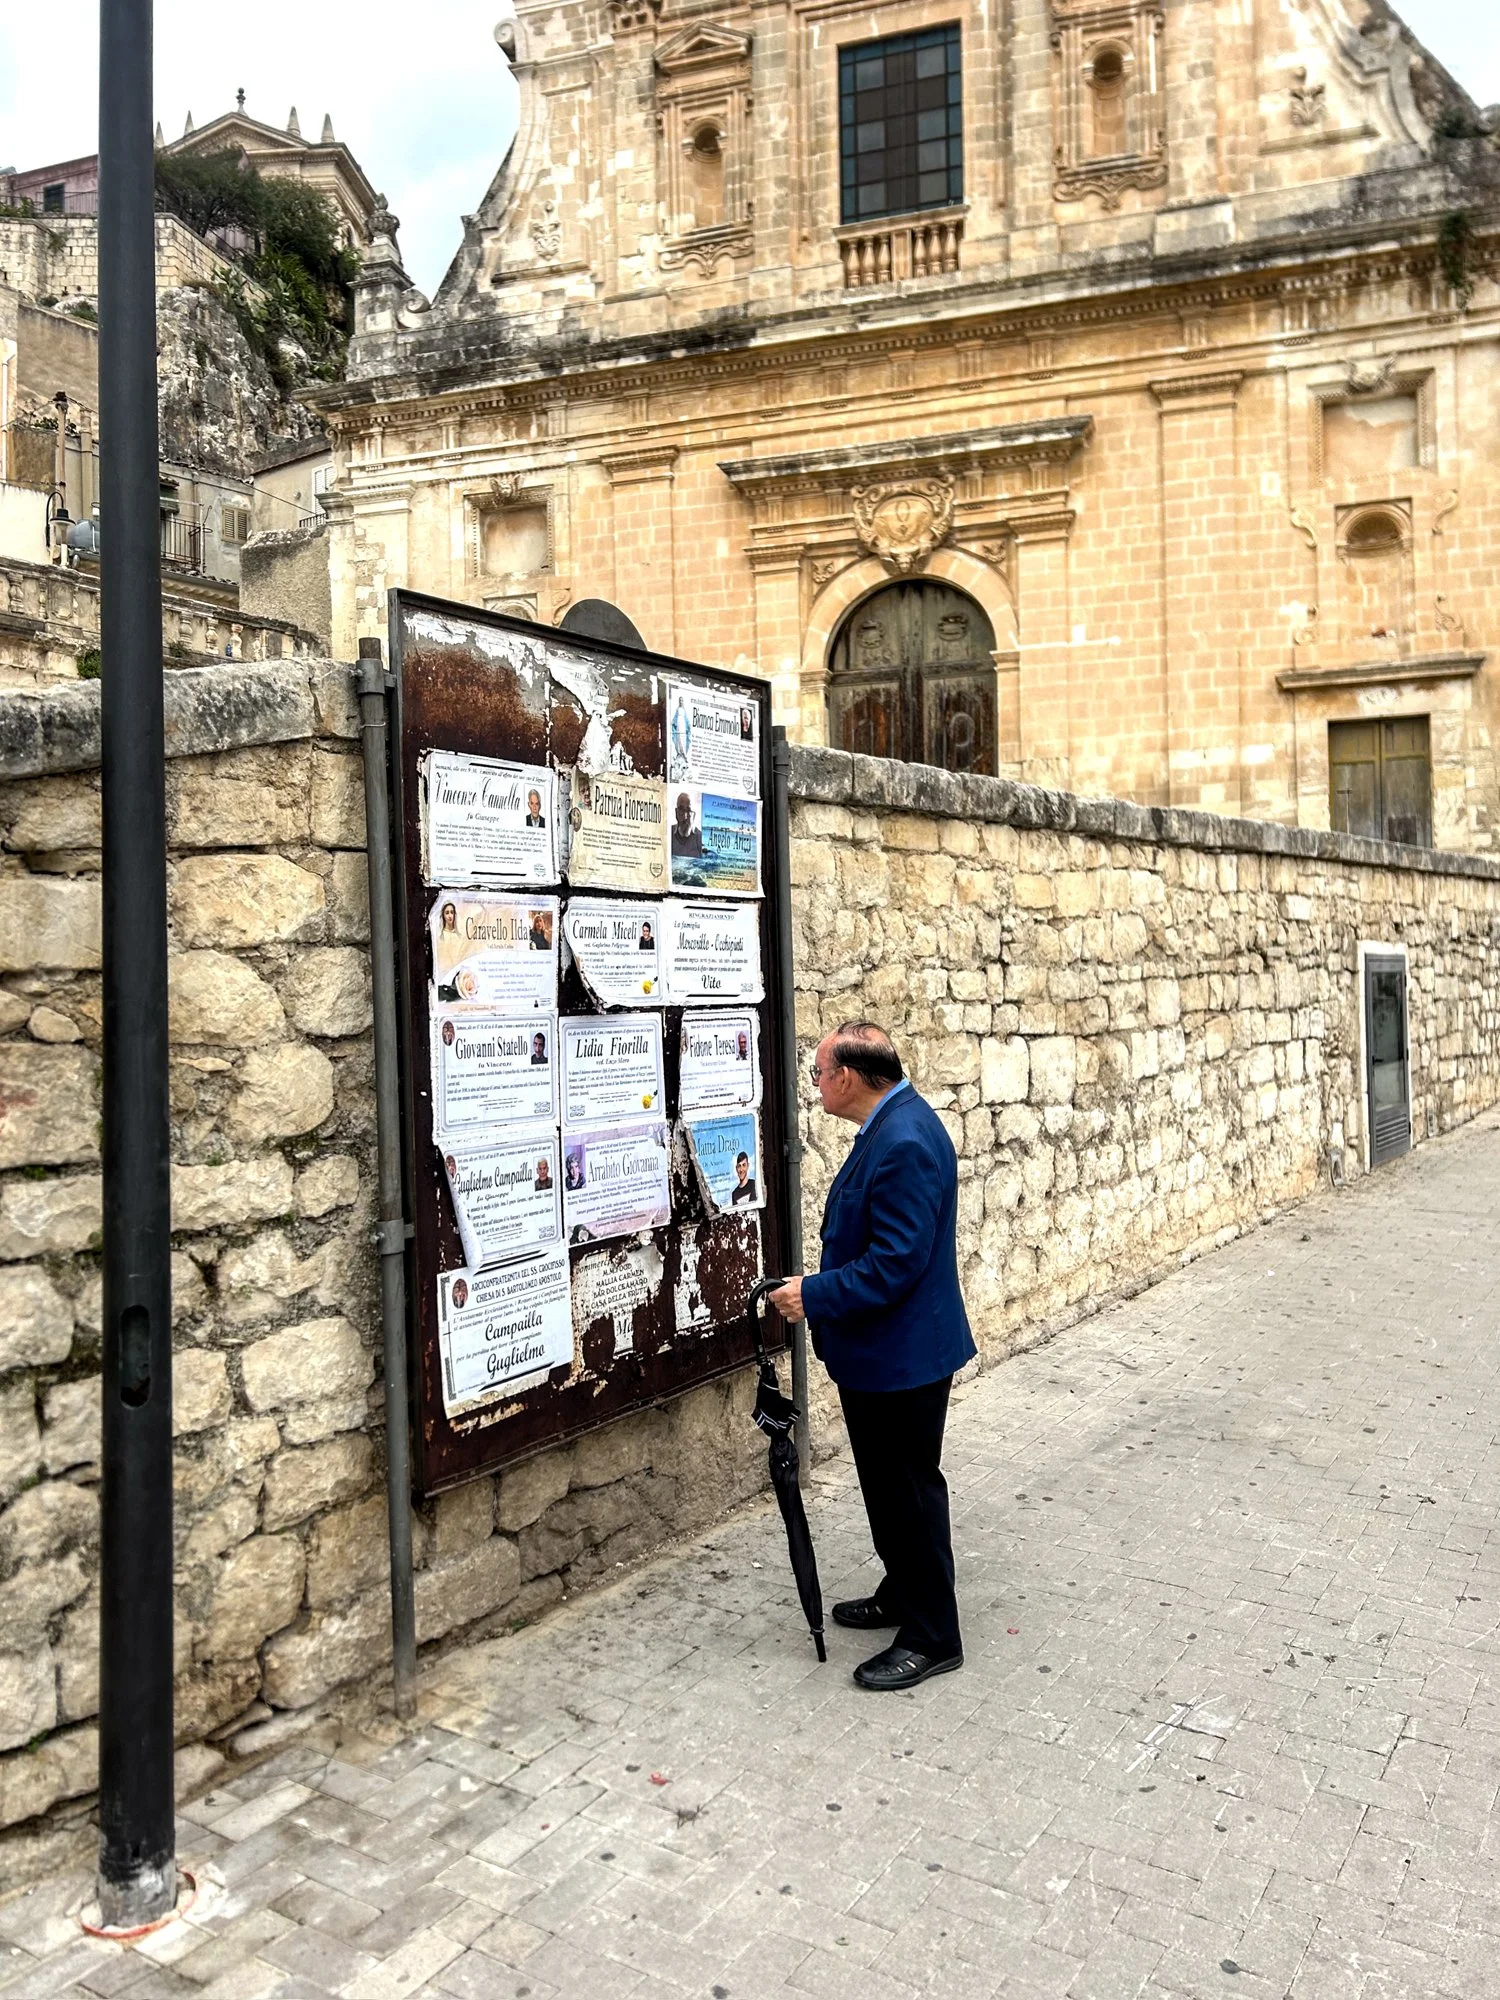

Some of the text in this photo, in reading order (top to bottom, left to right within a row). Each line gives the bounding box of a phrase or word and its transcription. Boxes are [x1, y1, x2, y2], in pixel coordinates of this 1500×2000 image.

[692, 706, 714, 731] Bianca
[434, 772, 521, 811] Vincenzo Cannella
[593, 785, 622, 818] Patrizia
[624, 791, 662, 824] Fiorentino
[707, 828, 731, 854] Angelo
[465, 916, 529, 941] Caravello Ilda
[572, 919, 638, 940] Carmela Miceli
[701, 974, 722, 989] Vito
[455, 1035, 528, 1060] Giovanni Statello
[575, 1035, 649, 1059] Lidia Fiorilla
[714, 1034, 736, 1056] Teresa
[717, 1134, 740, 1156] Drago
[588, 1153, 659, 1183] Arrabito Giovanna
[453, 1162, 533, 1200] Guglielmo Campailla
[471, 1271, 520, 1293] ARCICONFRATERNITA
[538, 1258, 566, 1273] CROCIFISSO
[476, 1292, 496, 1304] CHIESA
[507, 1279, 538, 1295] BARTOLOMEO
[539, 1272, 562, 1286] APOSTOLO
[596, 1269, 645, 1288] MALLIA CARMEN
[485, 1310, 543, 1342] Campailla
[486, 1342, 546, 1380] Guglielmo
